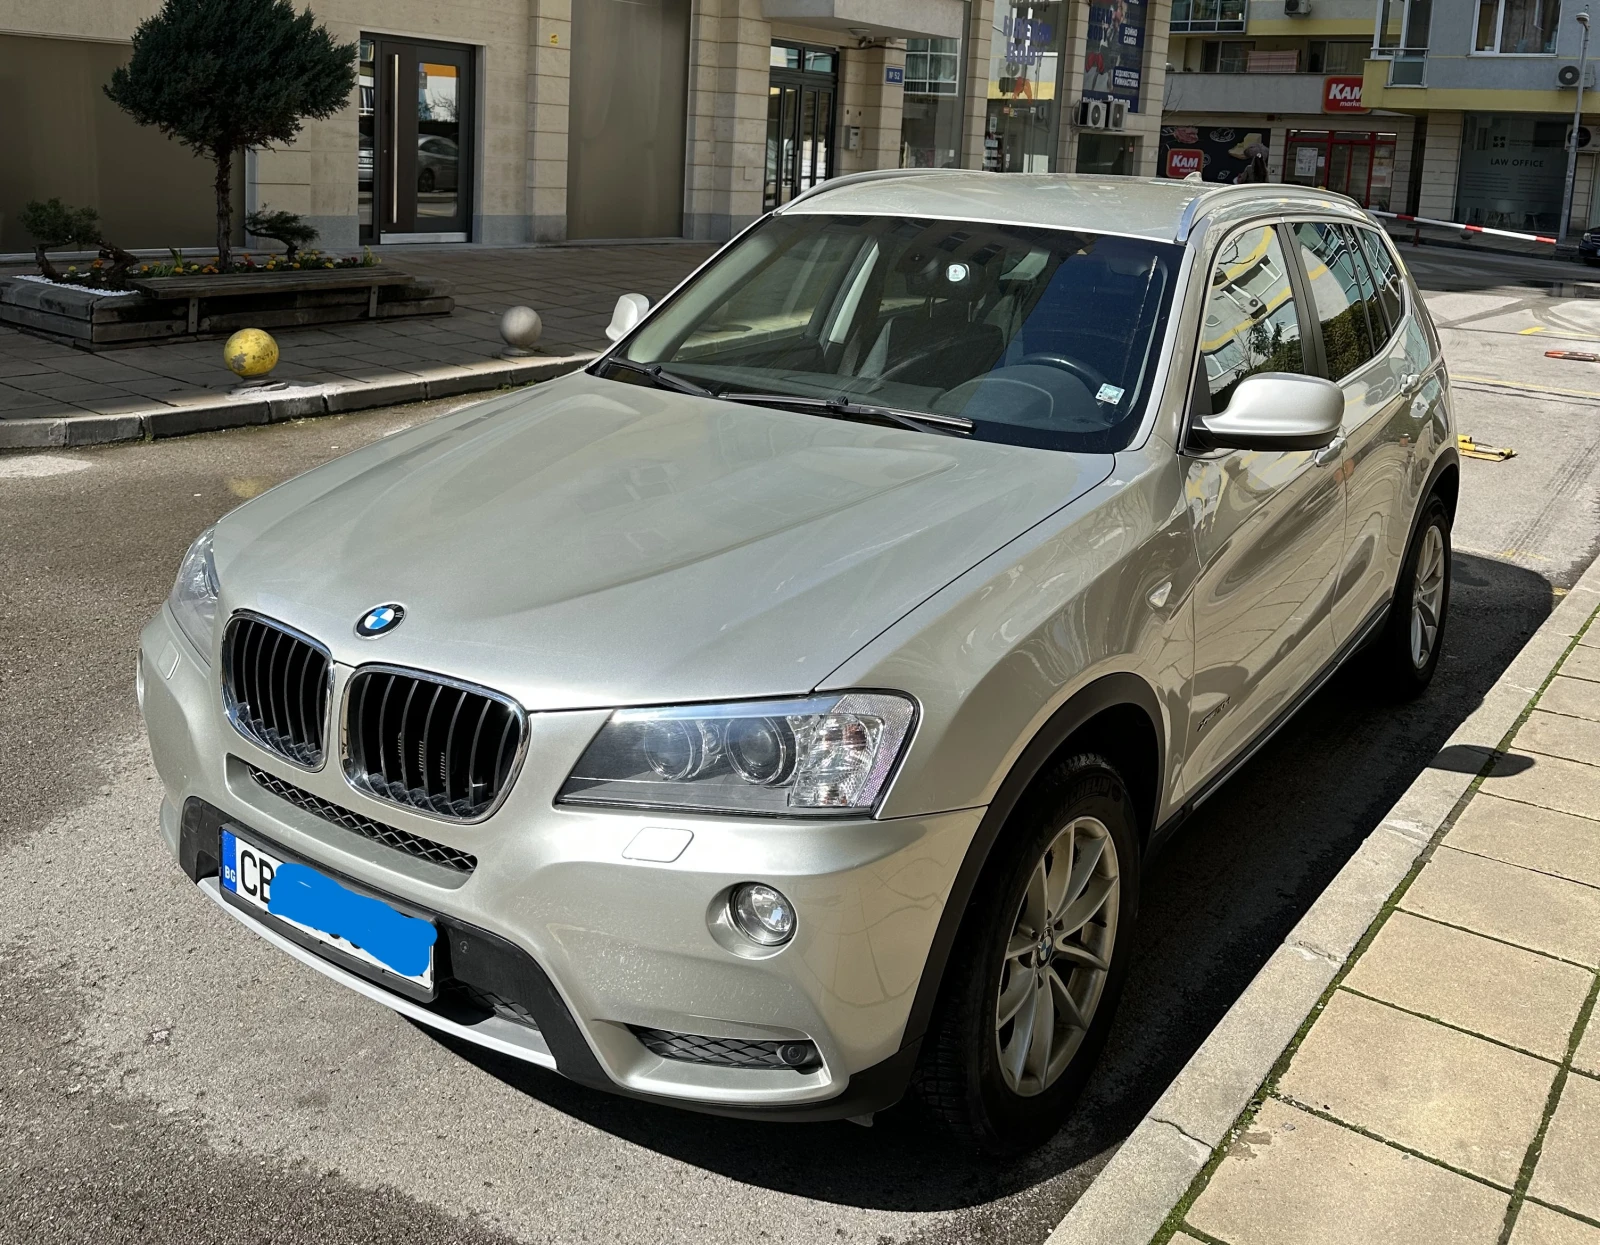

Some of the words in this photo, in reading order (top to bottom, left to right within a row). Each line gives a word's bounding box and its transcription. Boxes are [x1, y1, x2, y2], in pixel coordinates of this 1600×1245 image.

[1171, 154, 1199, 168] KAM
[1490, 158, 1509, 166] LAW
[1511, 158, 1545, 168] OFFICE
[224, 865, 236, 883] BG
